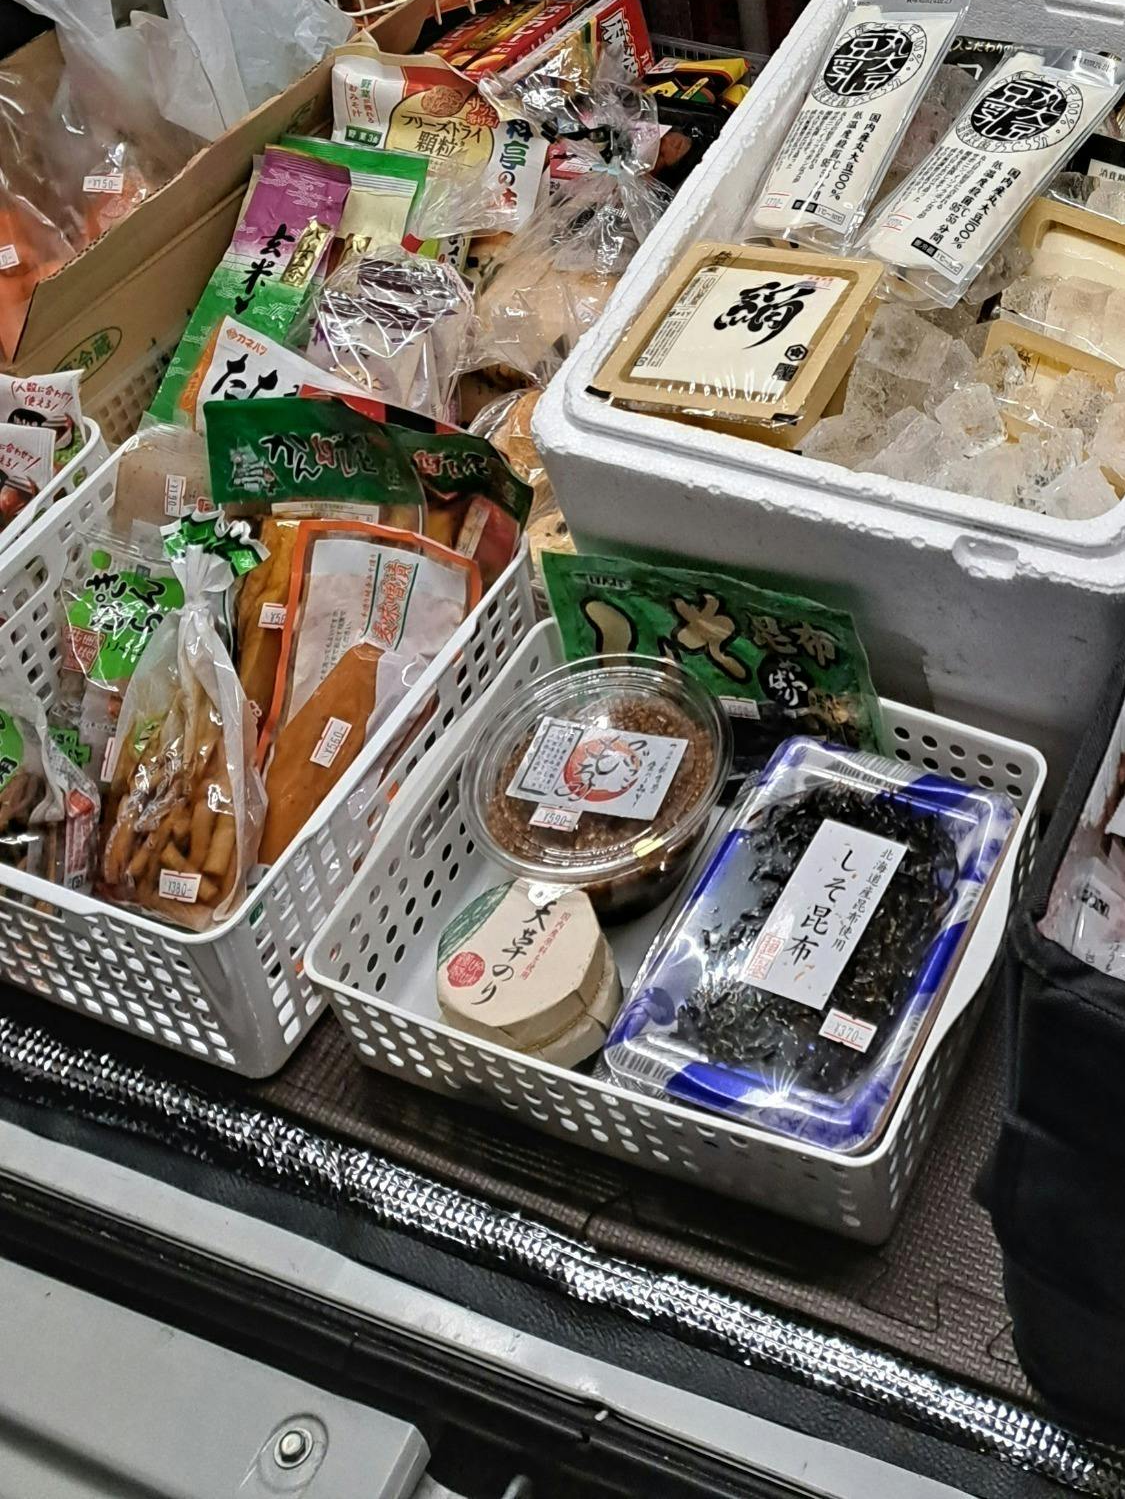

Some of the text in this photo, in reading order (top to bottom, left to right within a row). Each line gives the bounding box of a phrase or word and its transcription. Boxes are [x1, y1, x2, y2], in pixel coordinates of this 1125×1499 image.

[400, 114, 483, 144] フリーズドライ
[416, 130, 456, 159] 顆粒
[239, 333, 269, 357] カネハツ
[785, 842, 856, 966] しそ昆布
[831, 847, 895, 953] 北海道産昆布使用
